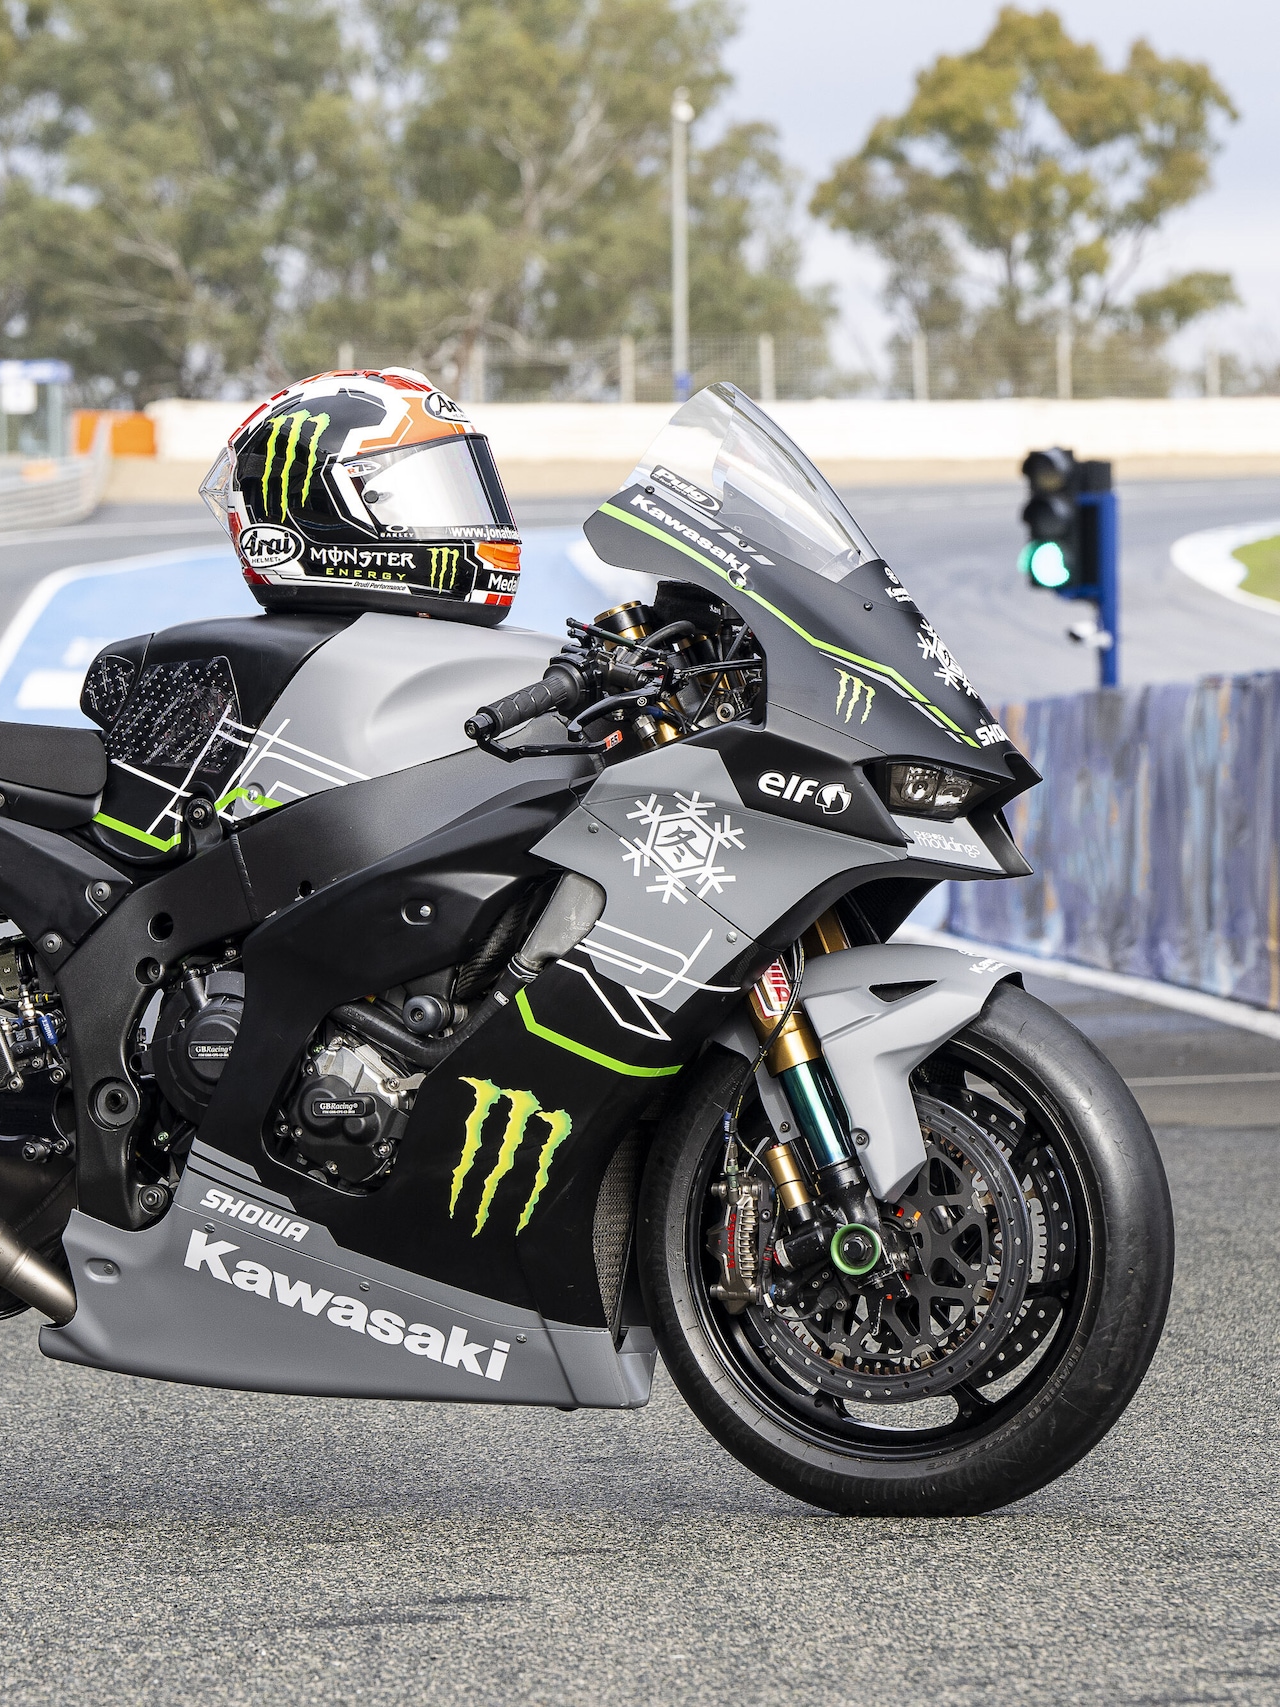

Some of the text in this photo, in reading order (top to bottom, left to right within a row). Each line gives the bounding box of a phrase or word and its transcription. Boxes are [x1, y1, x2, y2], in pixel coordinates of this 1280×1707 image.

[242, 531, 291, 556] Arai
[630, 494, 751, 574] Kawasaki
[310, 546, 416, 570] MONSTER
[326, 568, 406, 581] ENERGY
[975, 724, 1010, 747] SHO
[758, 772, 820, 804] elf
[200, 1188, 310, 1242] SHOWA
[726, 1213, 737, 1269] brembo
[183, 1229, 511, 1382] Kawasaki
